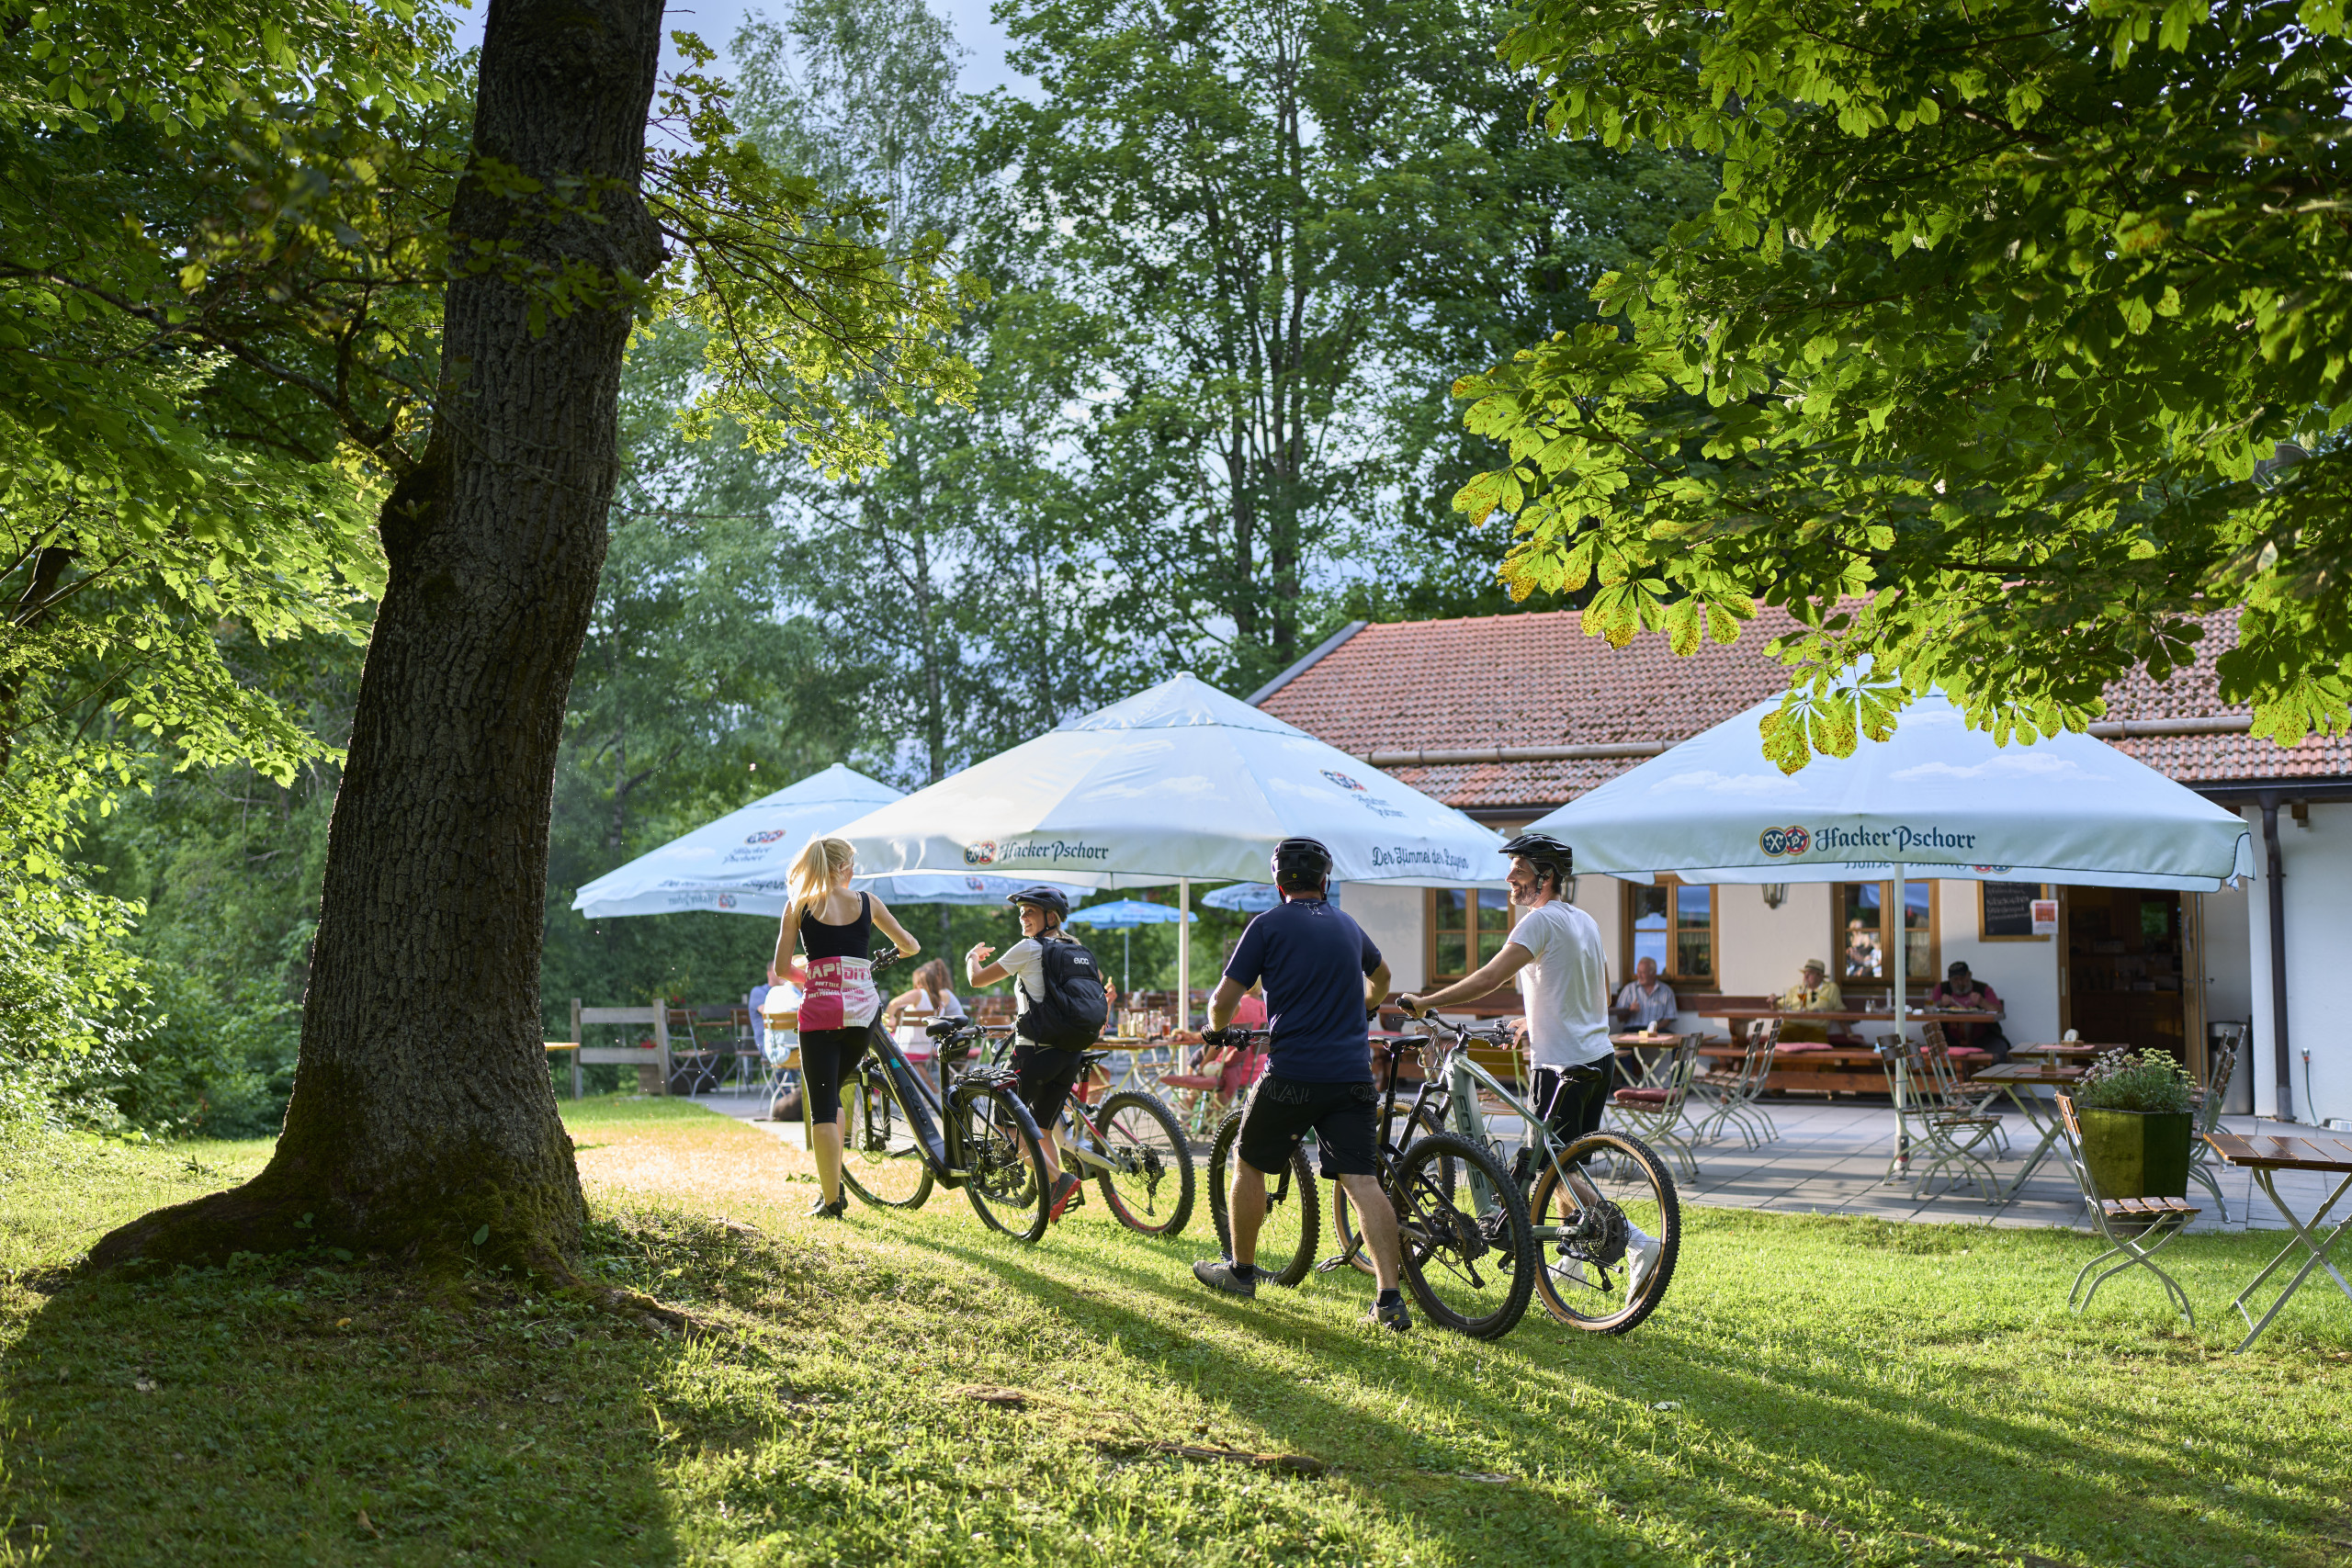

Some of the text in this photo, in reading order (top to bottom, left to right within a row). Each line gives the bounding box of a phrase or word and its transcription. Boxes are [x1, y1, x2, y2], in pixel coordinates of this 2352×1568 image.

[1892, 826, 1976, 853] Pschorr
[1051, 840, 1110, 863] Pschorr
[1373, 846, 1395, 866] Der
